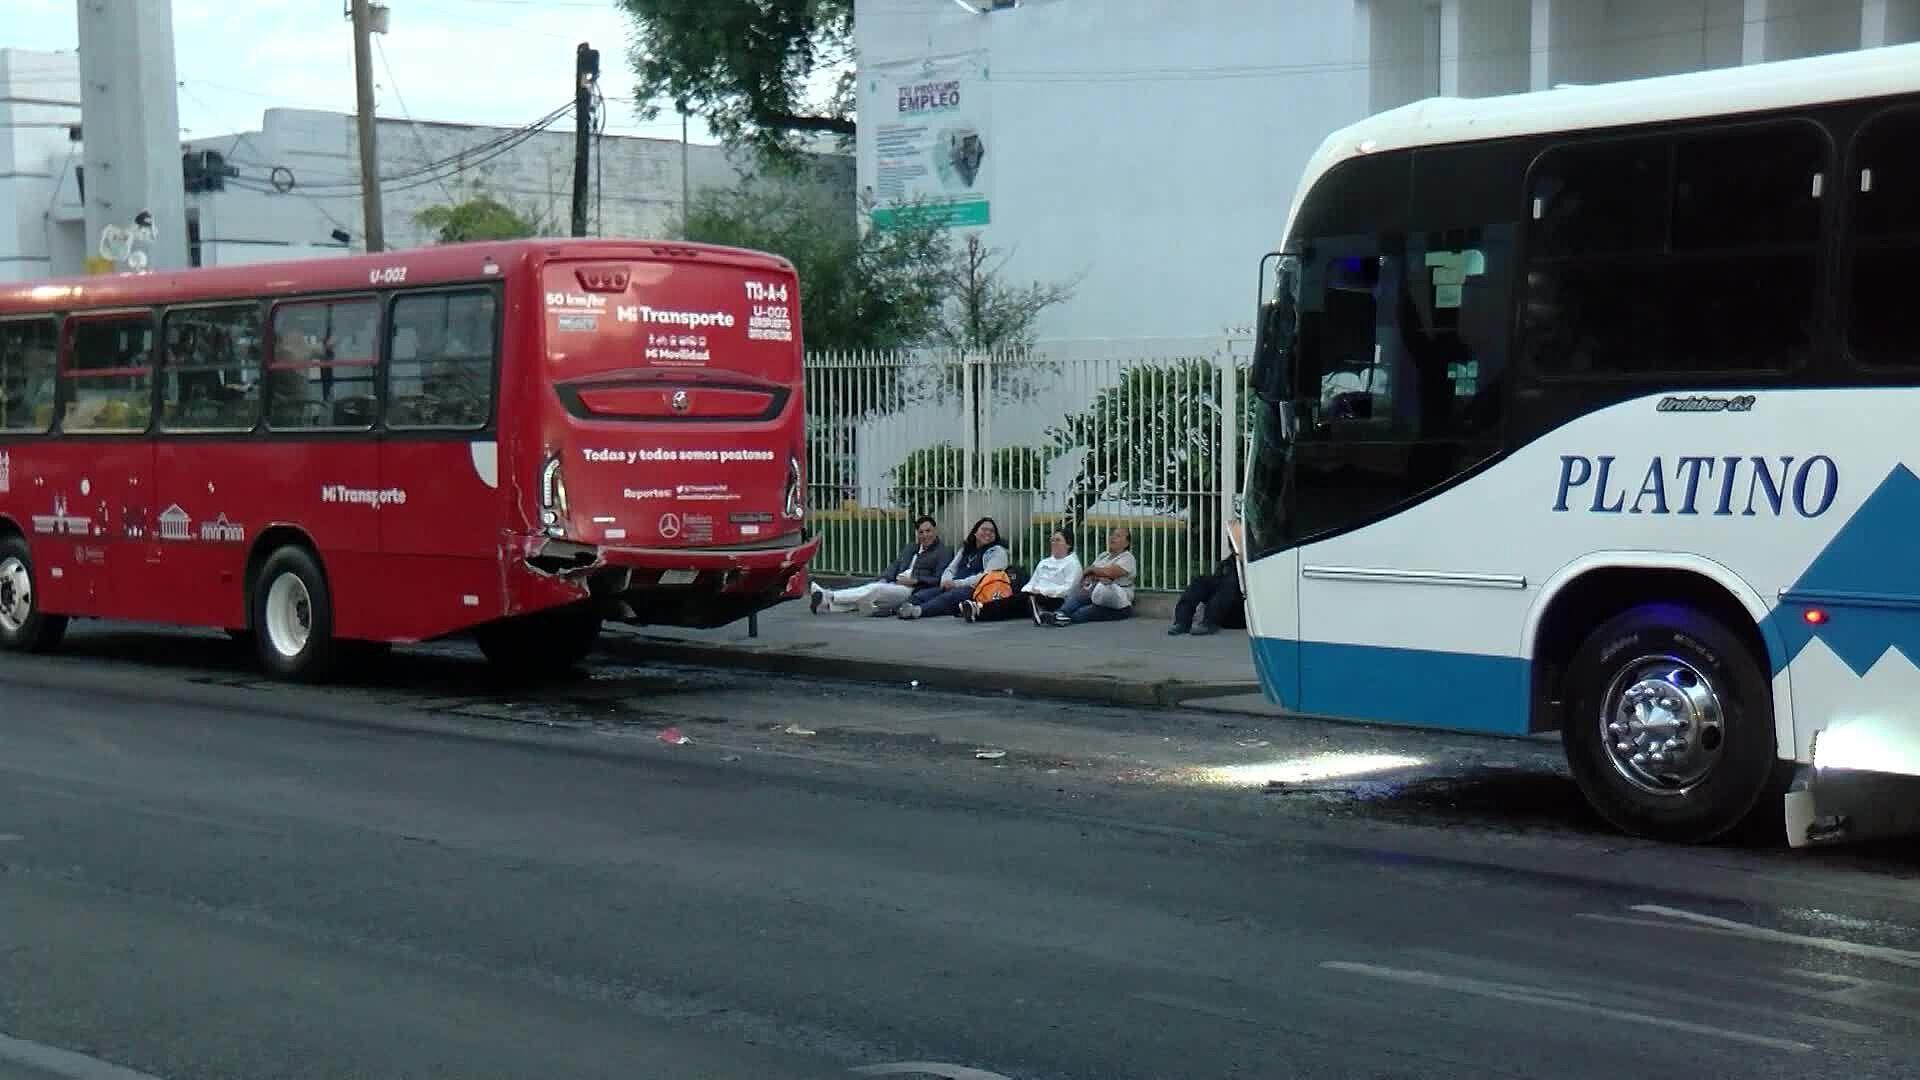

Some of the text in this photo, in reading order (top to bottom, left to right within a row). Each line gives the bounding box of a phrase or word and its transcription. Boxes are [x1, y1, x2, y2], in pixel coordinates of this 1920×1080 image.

[898, 91, 960, 111] EMPLEO
[546, 293, 564, 304] 50
[617, 306, 734, 329] Mi Transporte
[645, 349, 658, 359] Mi
[583, 448, 774, 463] Todas y todos somos peatones
[323, 485, 406, 508] Mi Transporte
[1552, 455, 1839, 518] PLATINO
